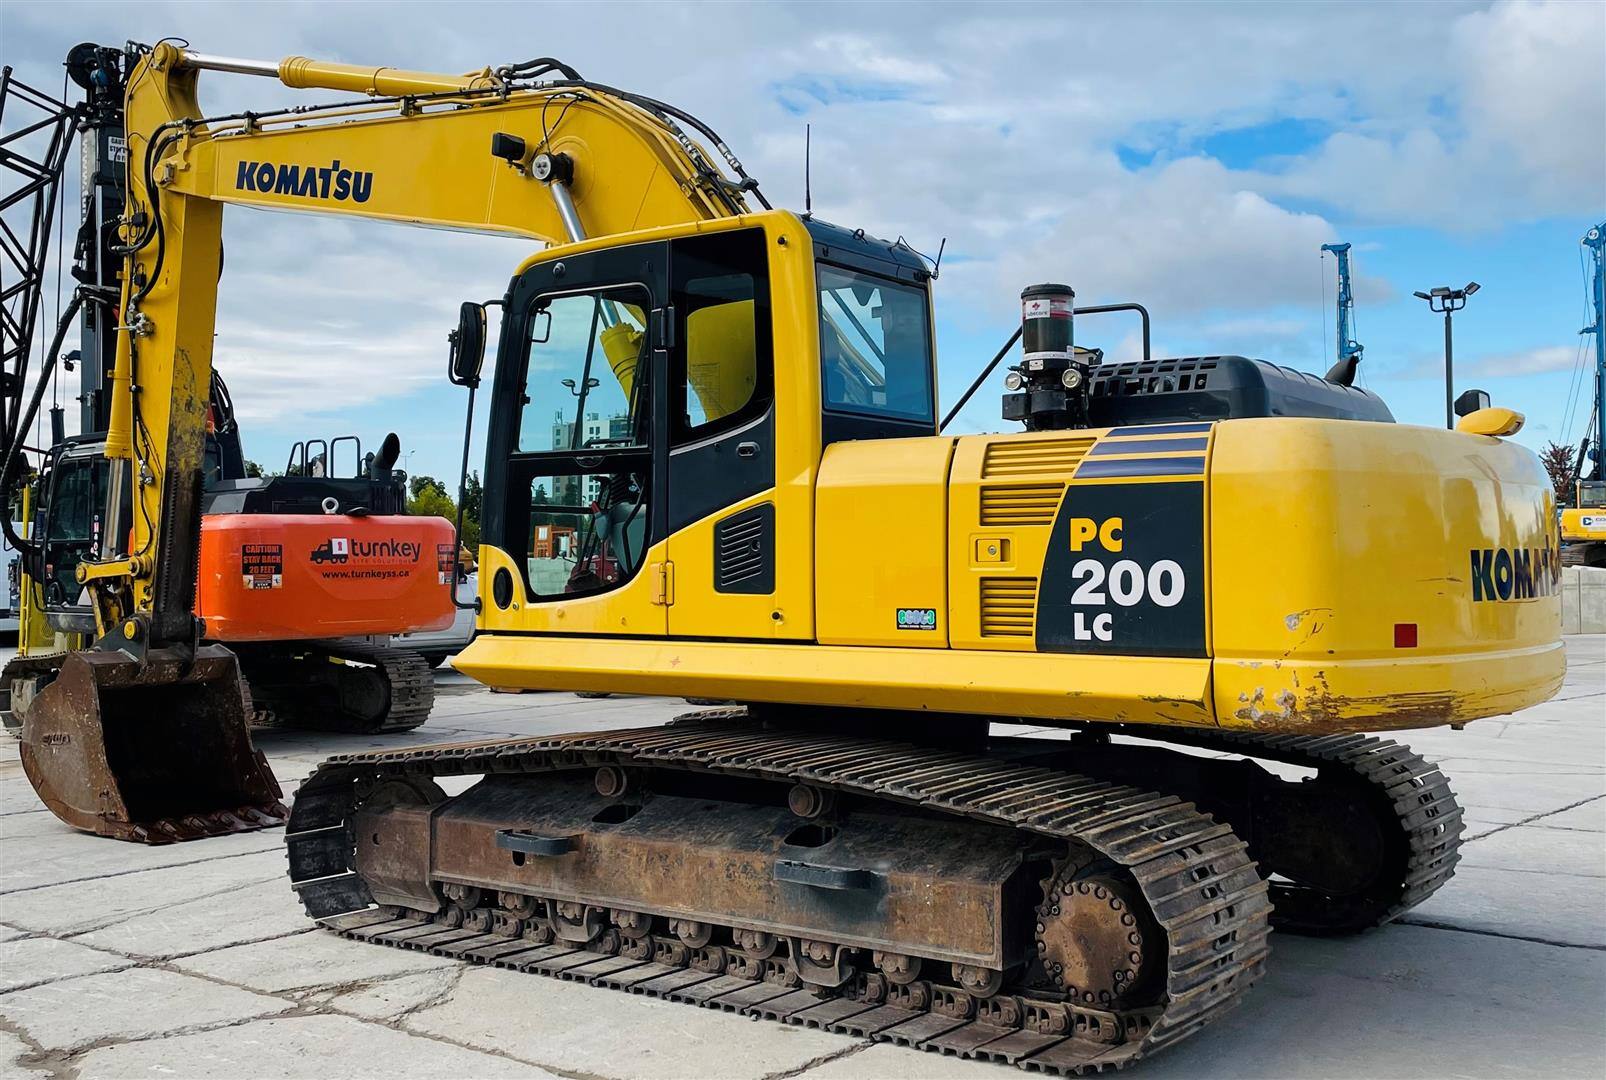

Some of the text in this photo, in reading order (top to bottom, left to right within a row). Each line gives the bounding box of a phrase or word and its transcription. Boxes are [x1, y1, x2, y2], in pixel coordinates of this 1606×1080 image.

[236, 160, 373, 203] KOMATSU
[1070, 517, 1123, 552] PC
[243, 555, 281, 563] STAY BACK
[245, 545, 279, 553] CAUTION!
[351, 538, 421, 562] turnkey
[249, 565, 275, 573] 20 FEET
[322, 570, 410, 579] www.turnkeyss.ca
[1070, 559, 1185, 607] 200
[1074, 612, 1113, 641] LC
